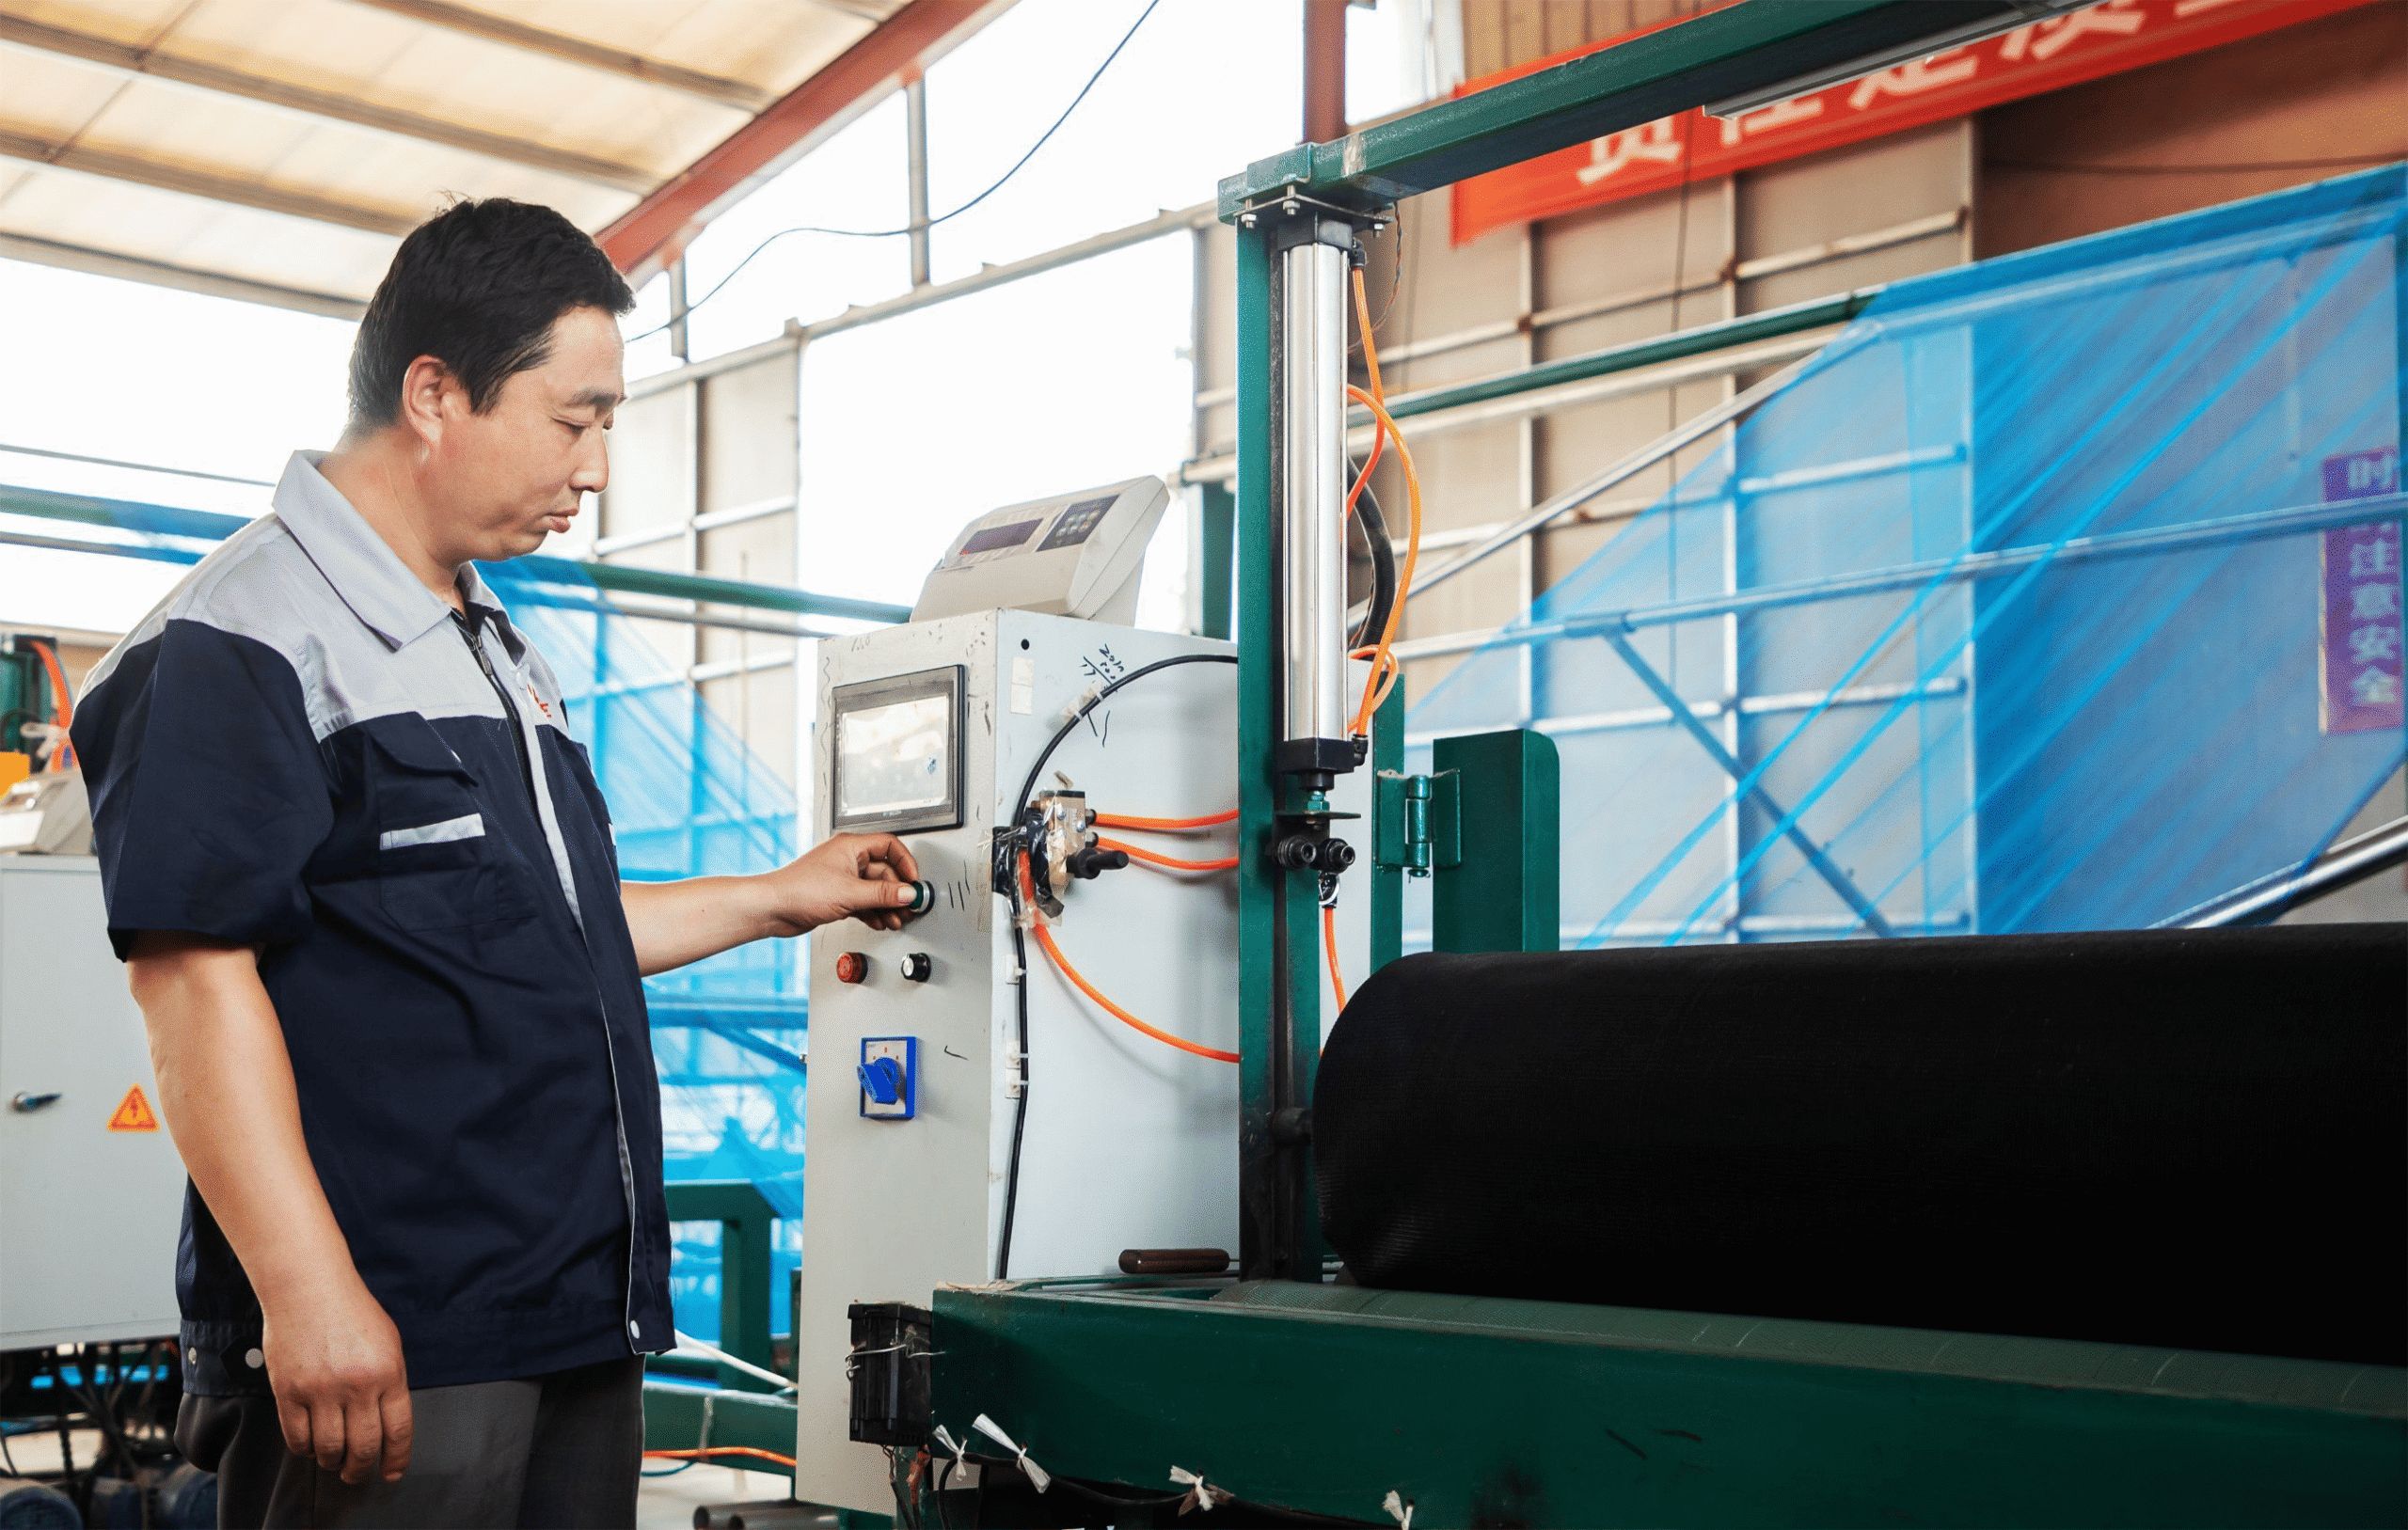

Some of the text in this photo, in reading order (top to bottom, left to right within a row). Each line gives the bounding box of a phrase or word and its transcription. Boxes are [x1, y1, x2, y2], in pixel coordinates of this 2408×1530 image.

[2349, 451, 2397, 704] 时注意安全
